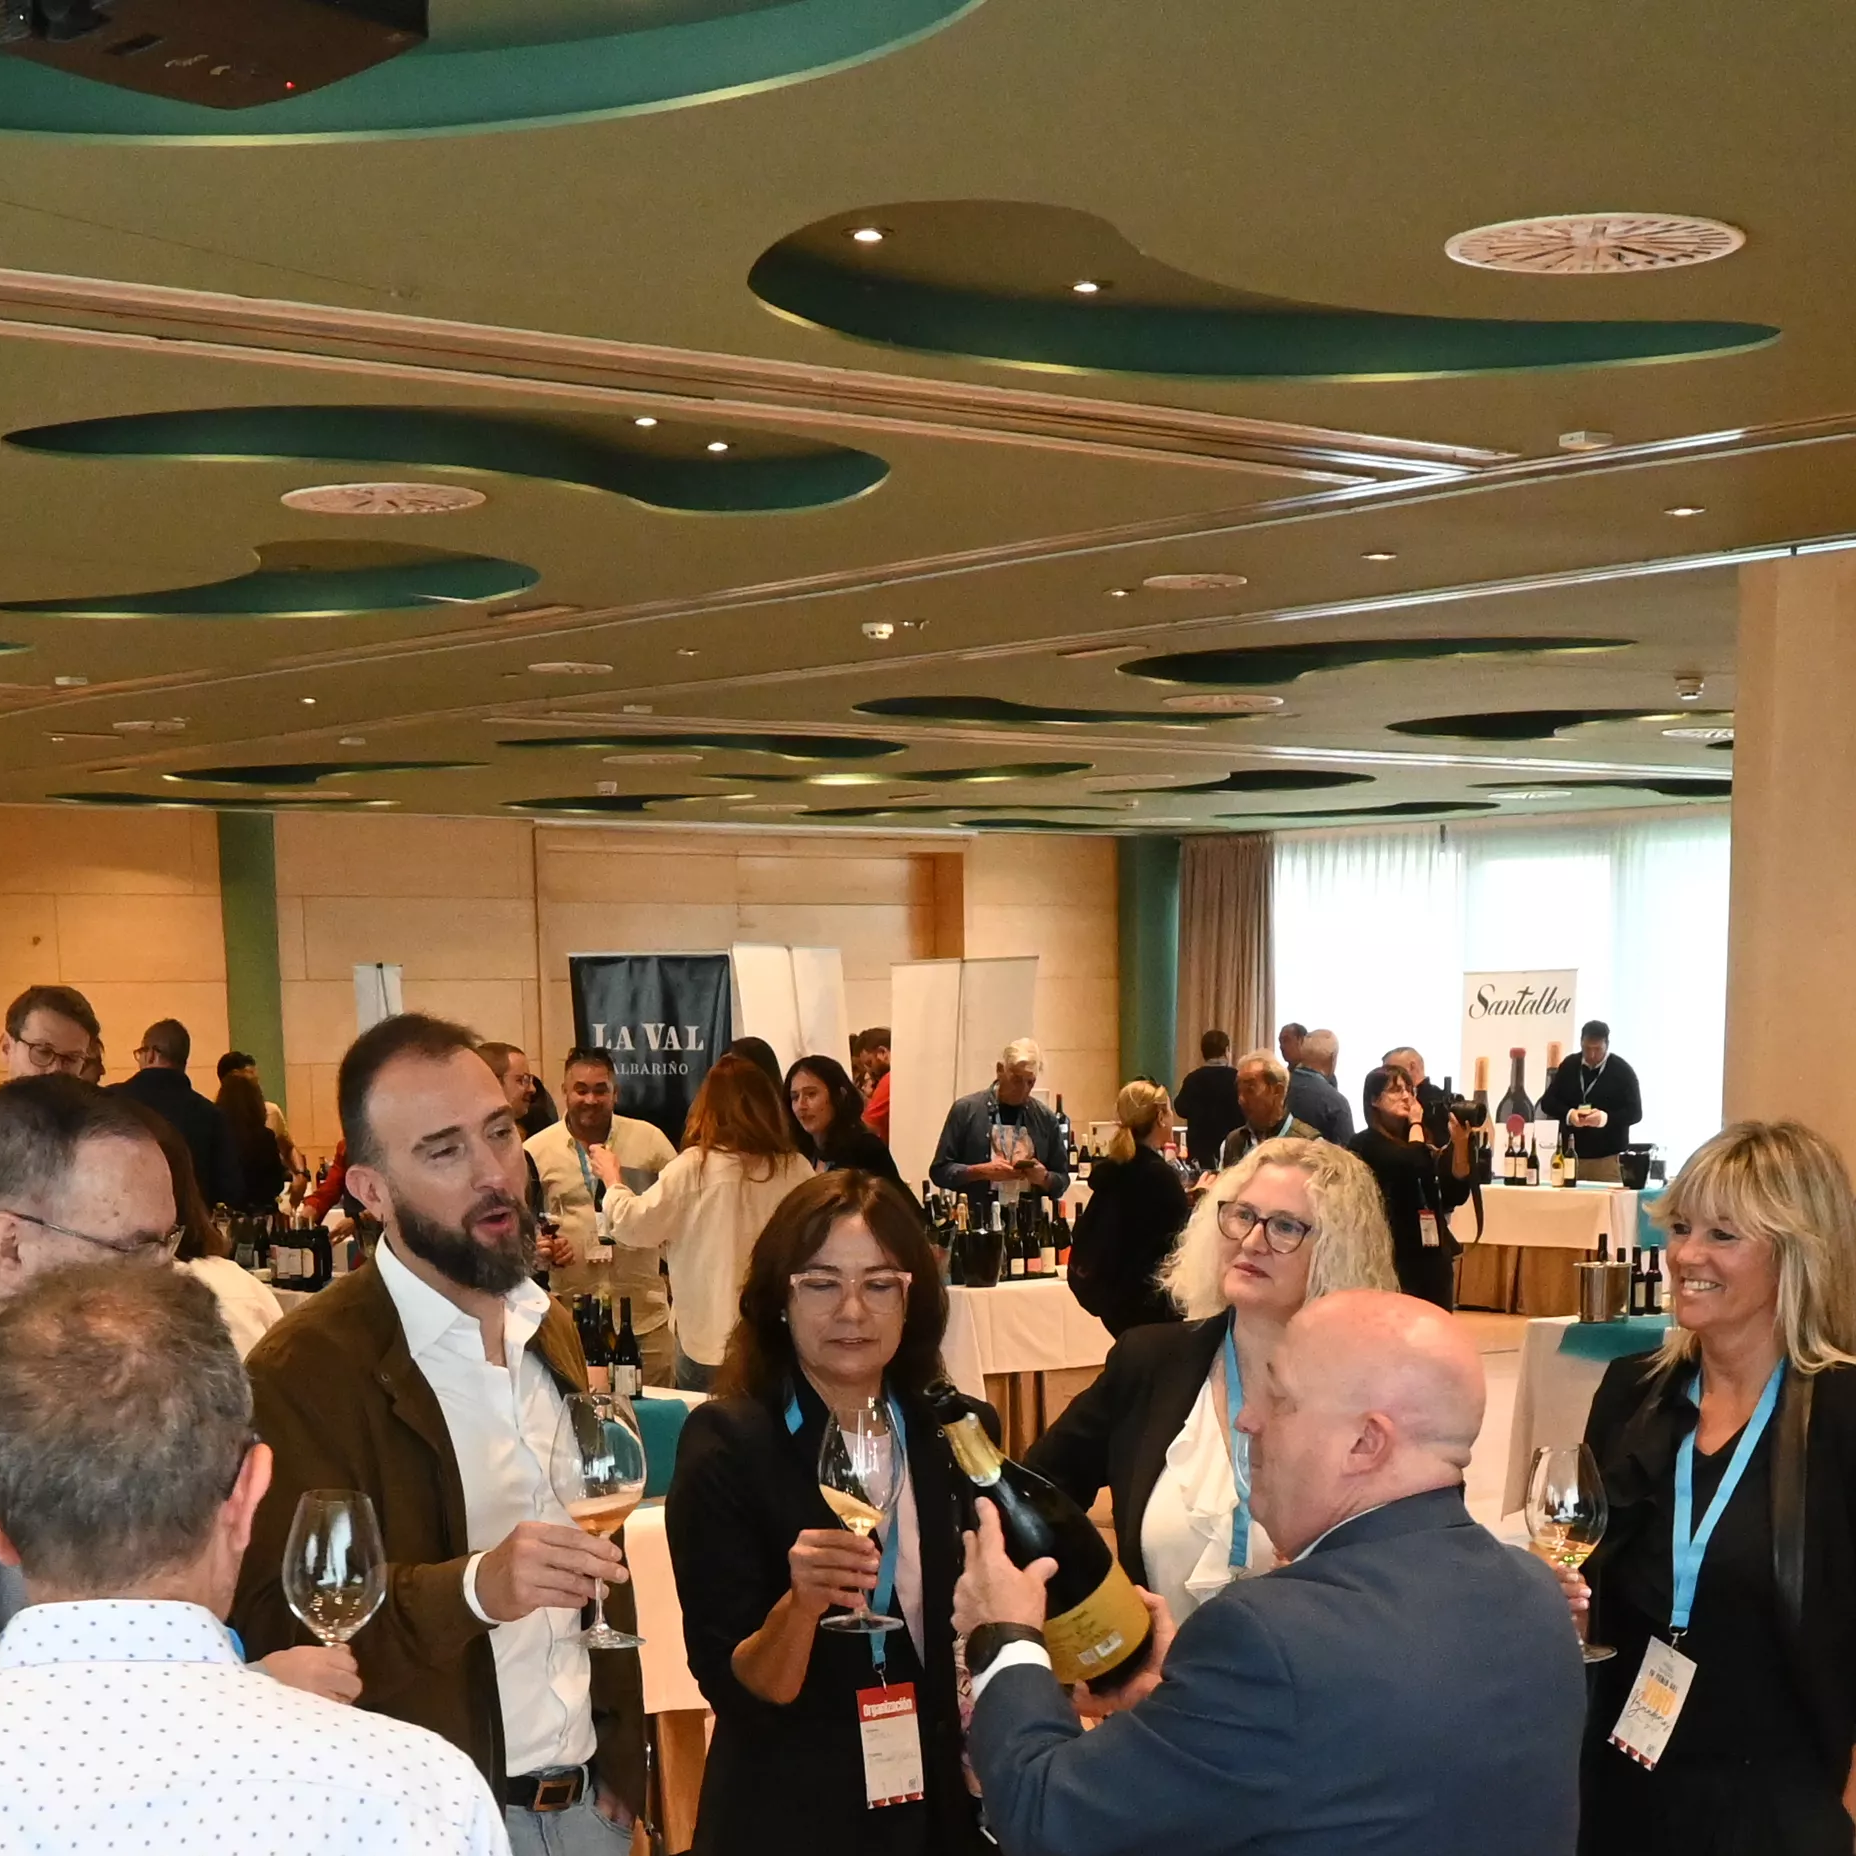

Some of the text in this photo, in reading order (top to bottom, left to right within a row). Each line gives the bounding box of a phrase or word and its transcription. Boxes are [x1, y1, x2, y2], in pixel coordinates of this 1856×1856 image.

[1468, 983, 1572, 1019] Santalba
[592, 1022, 705, 1051] LA VAL
[613, 1060, 689, 1076] ALBARIÑO
